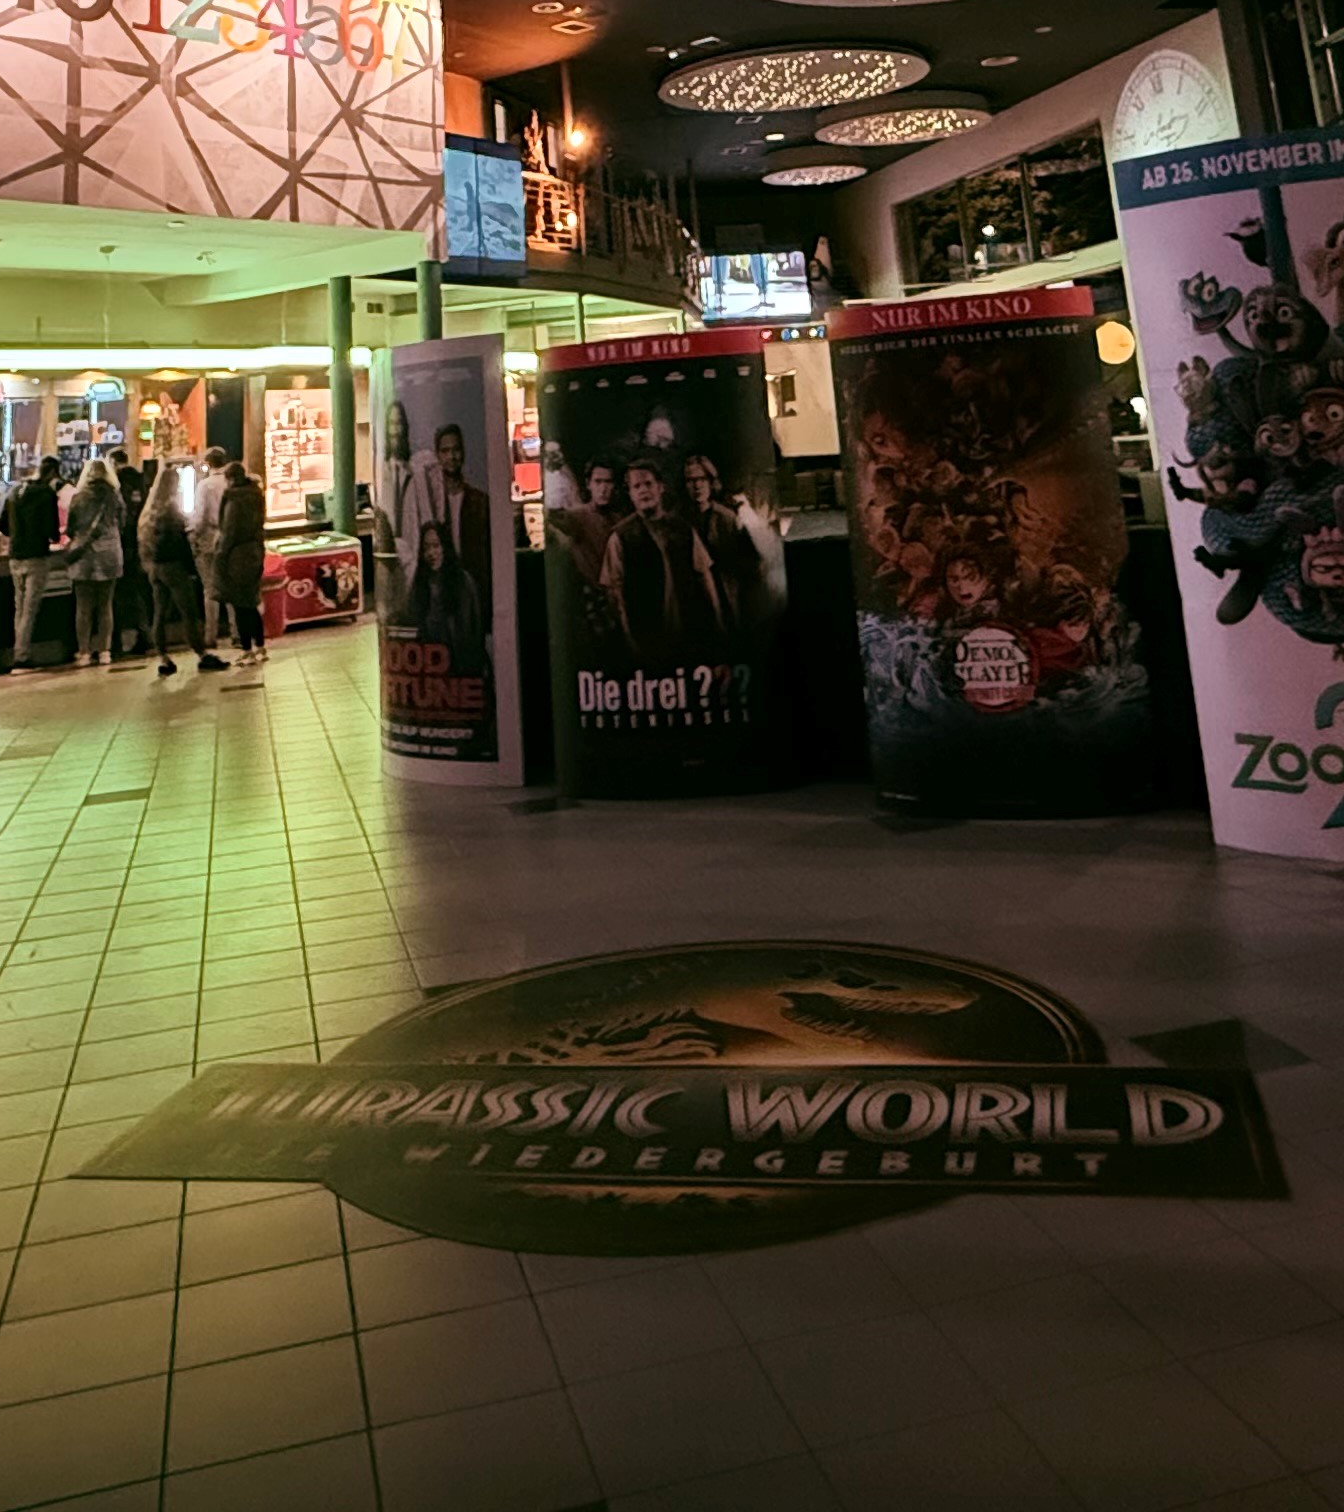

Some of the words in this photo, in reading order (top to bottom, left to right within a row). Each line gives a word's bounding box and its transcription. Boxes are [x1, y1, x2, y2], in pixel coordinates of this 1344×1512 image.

[1142, 167, 1166, 191] AB
[1168, 161, 1199, 187] 26.
[1201, 143, 1327, 179] NOVEMBER
[871, 307, 922, 330] NUR
[926, 301, 960, 325] IM
[964, 295, 1031, 321] KINO
[587, 343, 617, 362] NUR
[623, 339, 644, 357] IM
[650, 337, 691, 356] KINO
[385, 640, 451, 674] OOD
[577, 670, 622, 712] Die
[626, 666, 688, 712] drei
[692, 663, 753, 708] ???
[208, 1079, 685, 1138] JURASSIC
[724, 1079, 1224, 1148] WORLD
[402, 1143, 1109, 1179] WIEDERGEBURT
